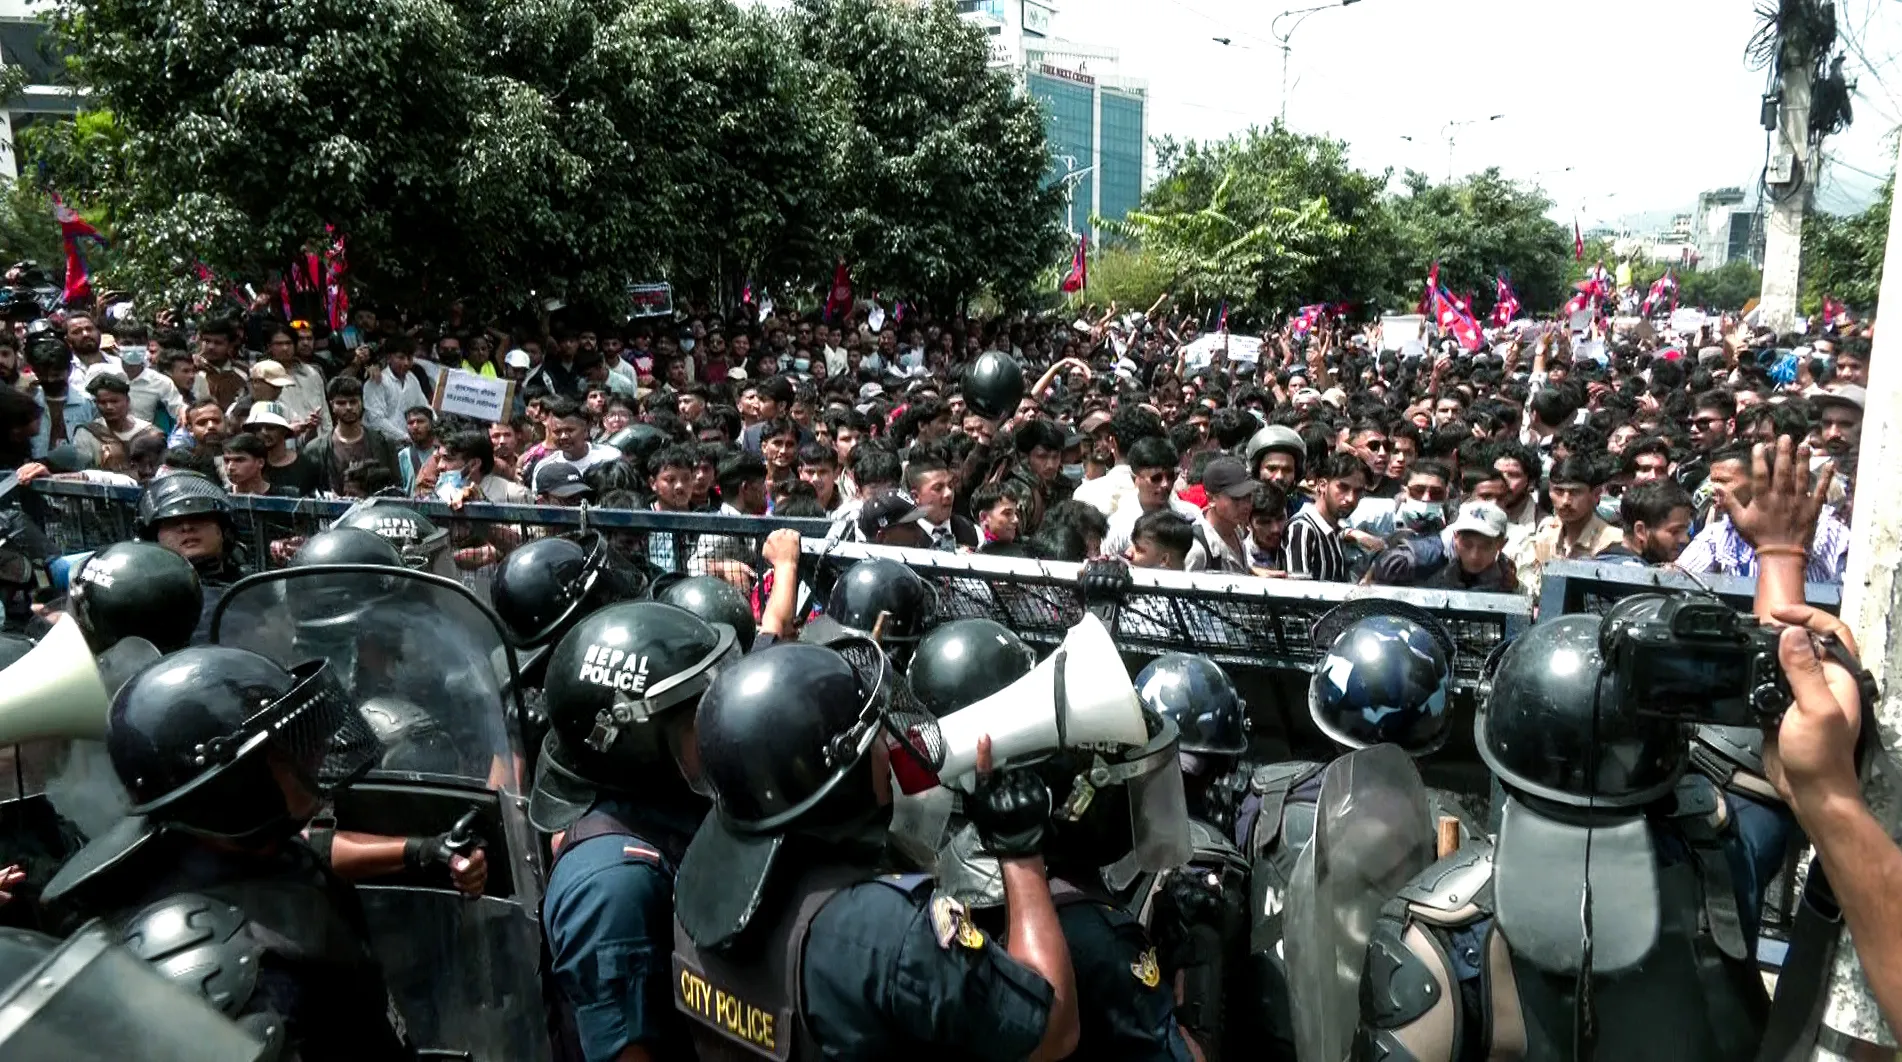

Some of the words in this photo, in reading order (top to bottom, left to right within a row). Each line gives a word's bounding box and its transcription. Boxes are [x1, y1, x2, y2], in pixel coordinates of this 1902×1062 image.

[583, 644, 649, 675] NEPAL
[579, 663, 647, 693] POLICE
[681, 969, 711, 1017] CITY
[716, 989, 774, 1050] POLICE
